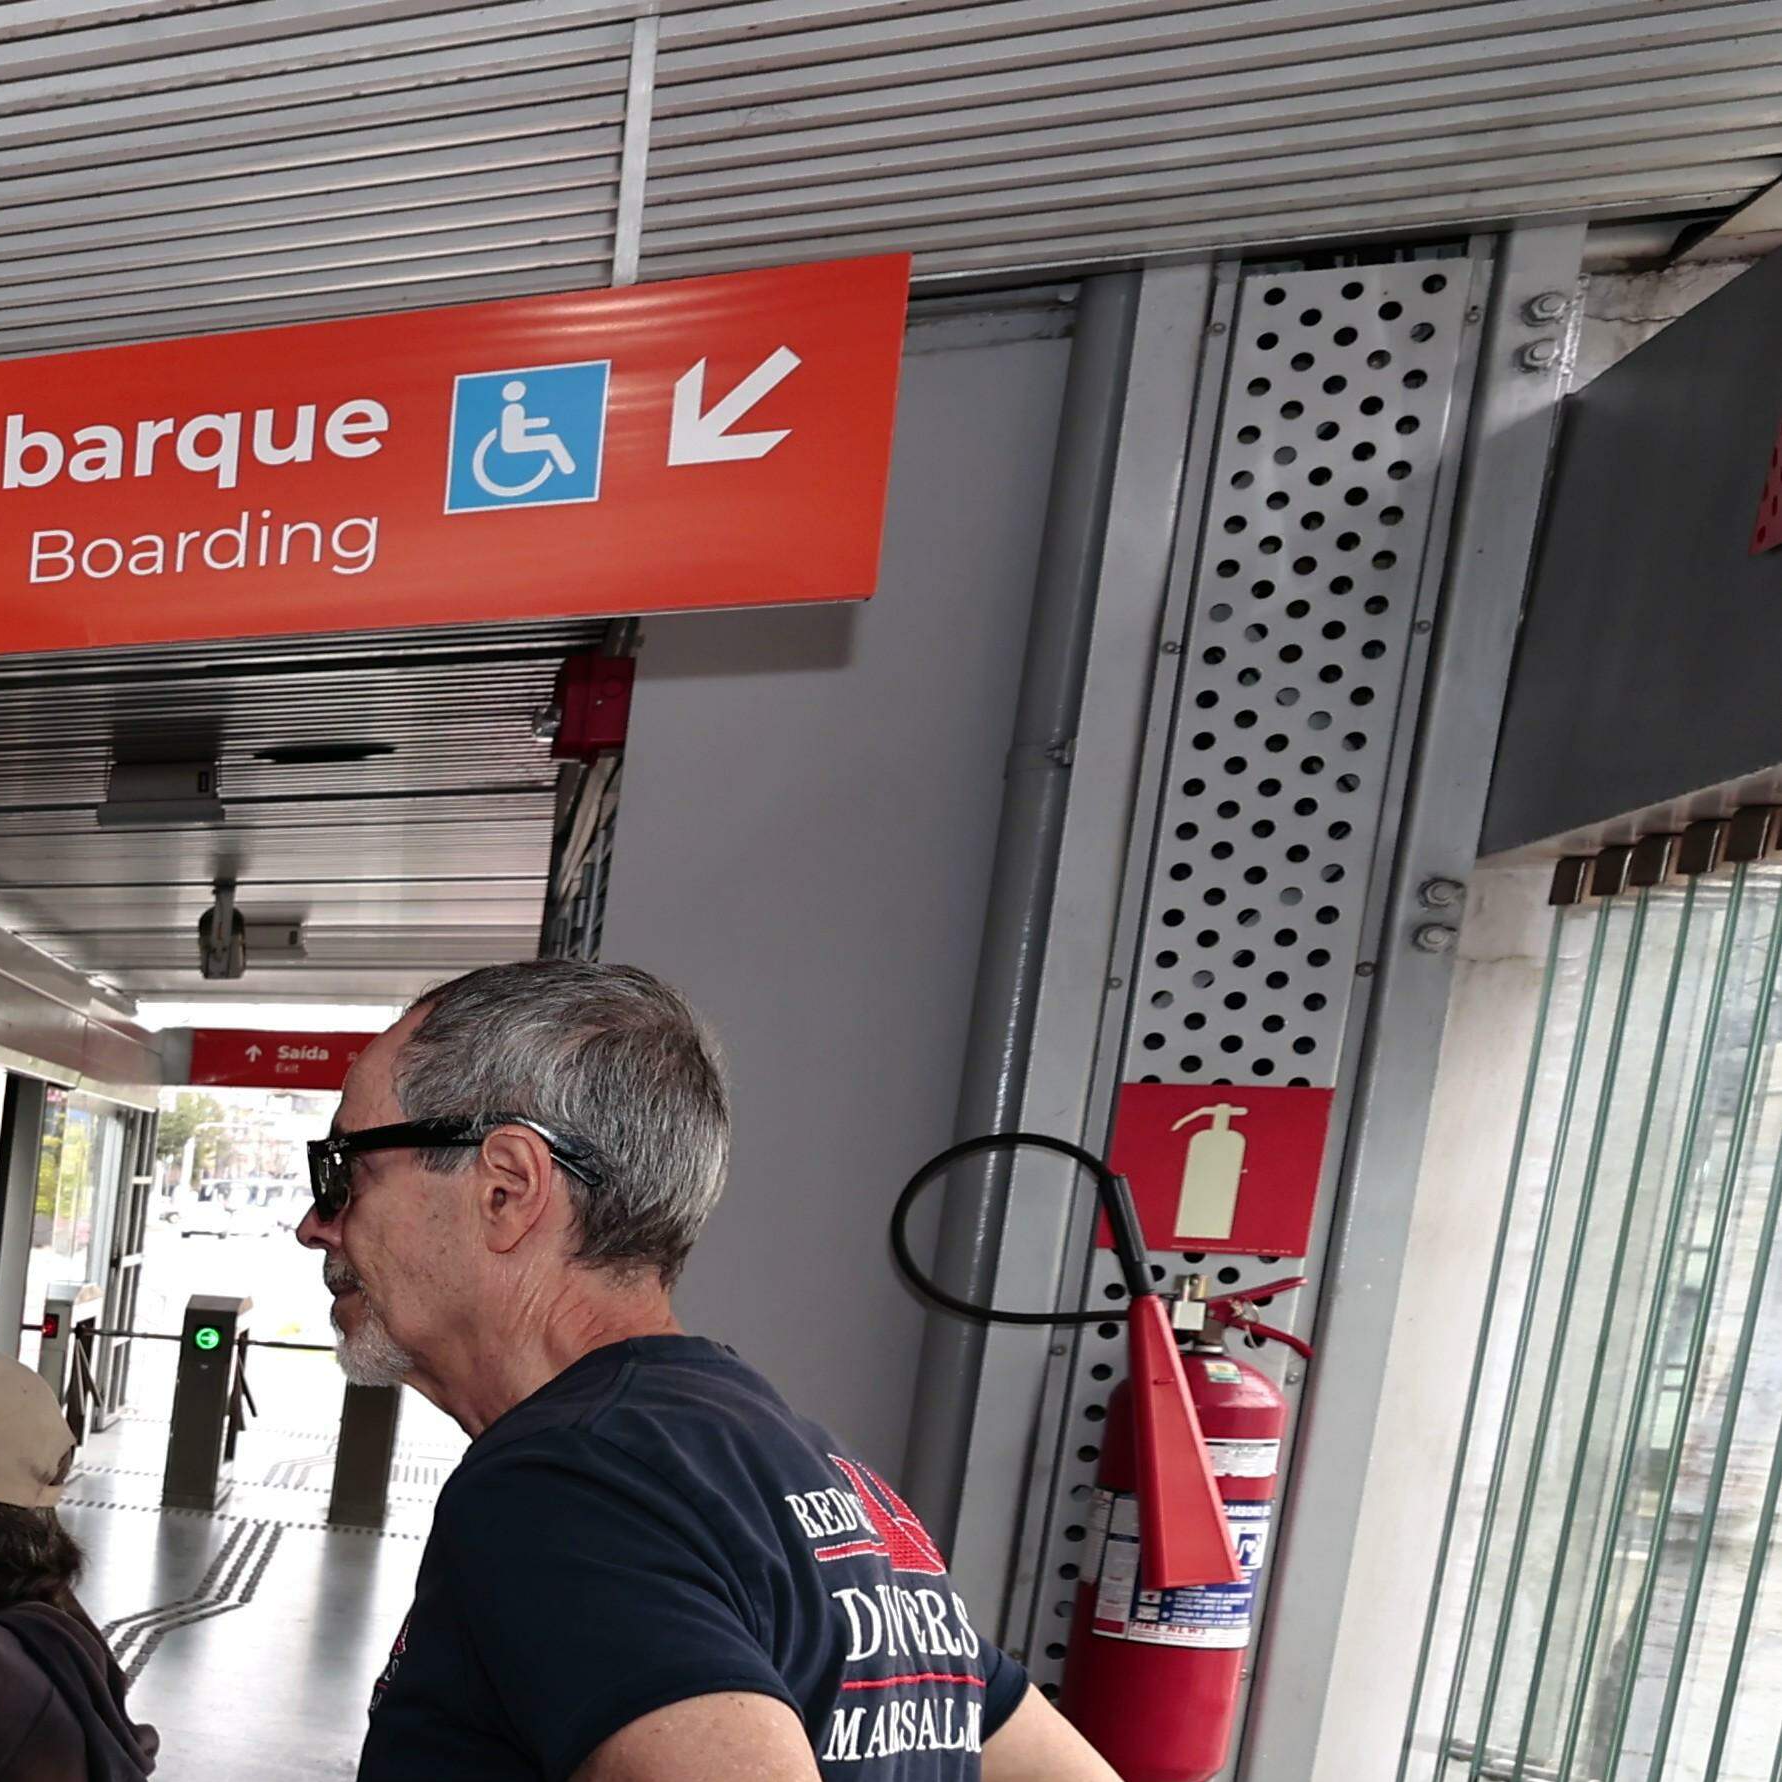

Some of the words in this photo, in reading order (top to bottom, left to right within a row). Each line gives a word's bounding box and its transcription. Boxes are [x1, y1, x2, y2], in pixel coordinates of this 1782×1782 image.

[28, 510, 380, 584] Boarding
[275, 1062, 300, 1073] Exit
[277, 1045, 329, 1060] Saída
[832, 1584, 979, 1661] DIVERS
